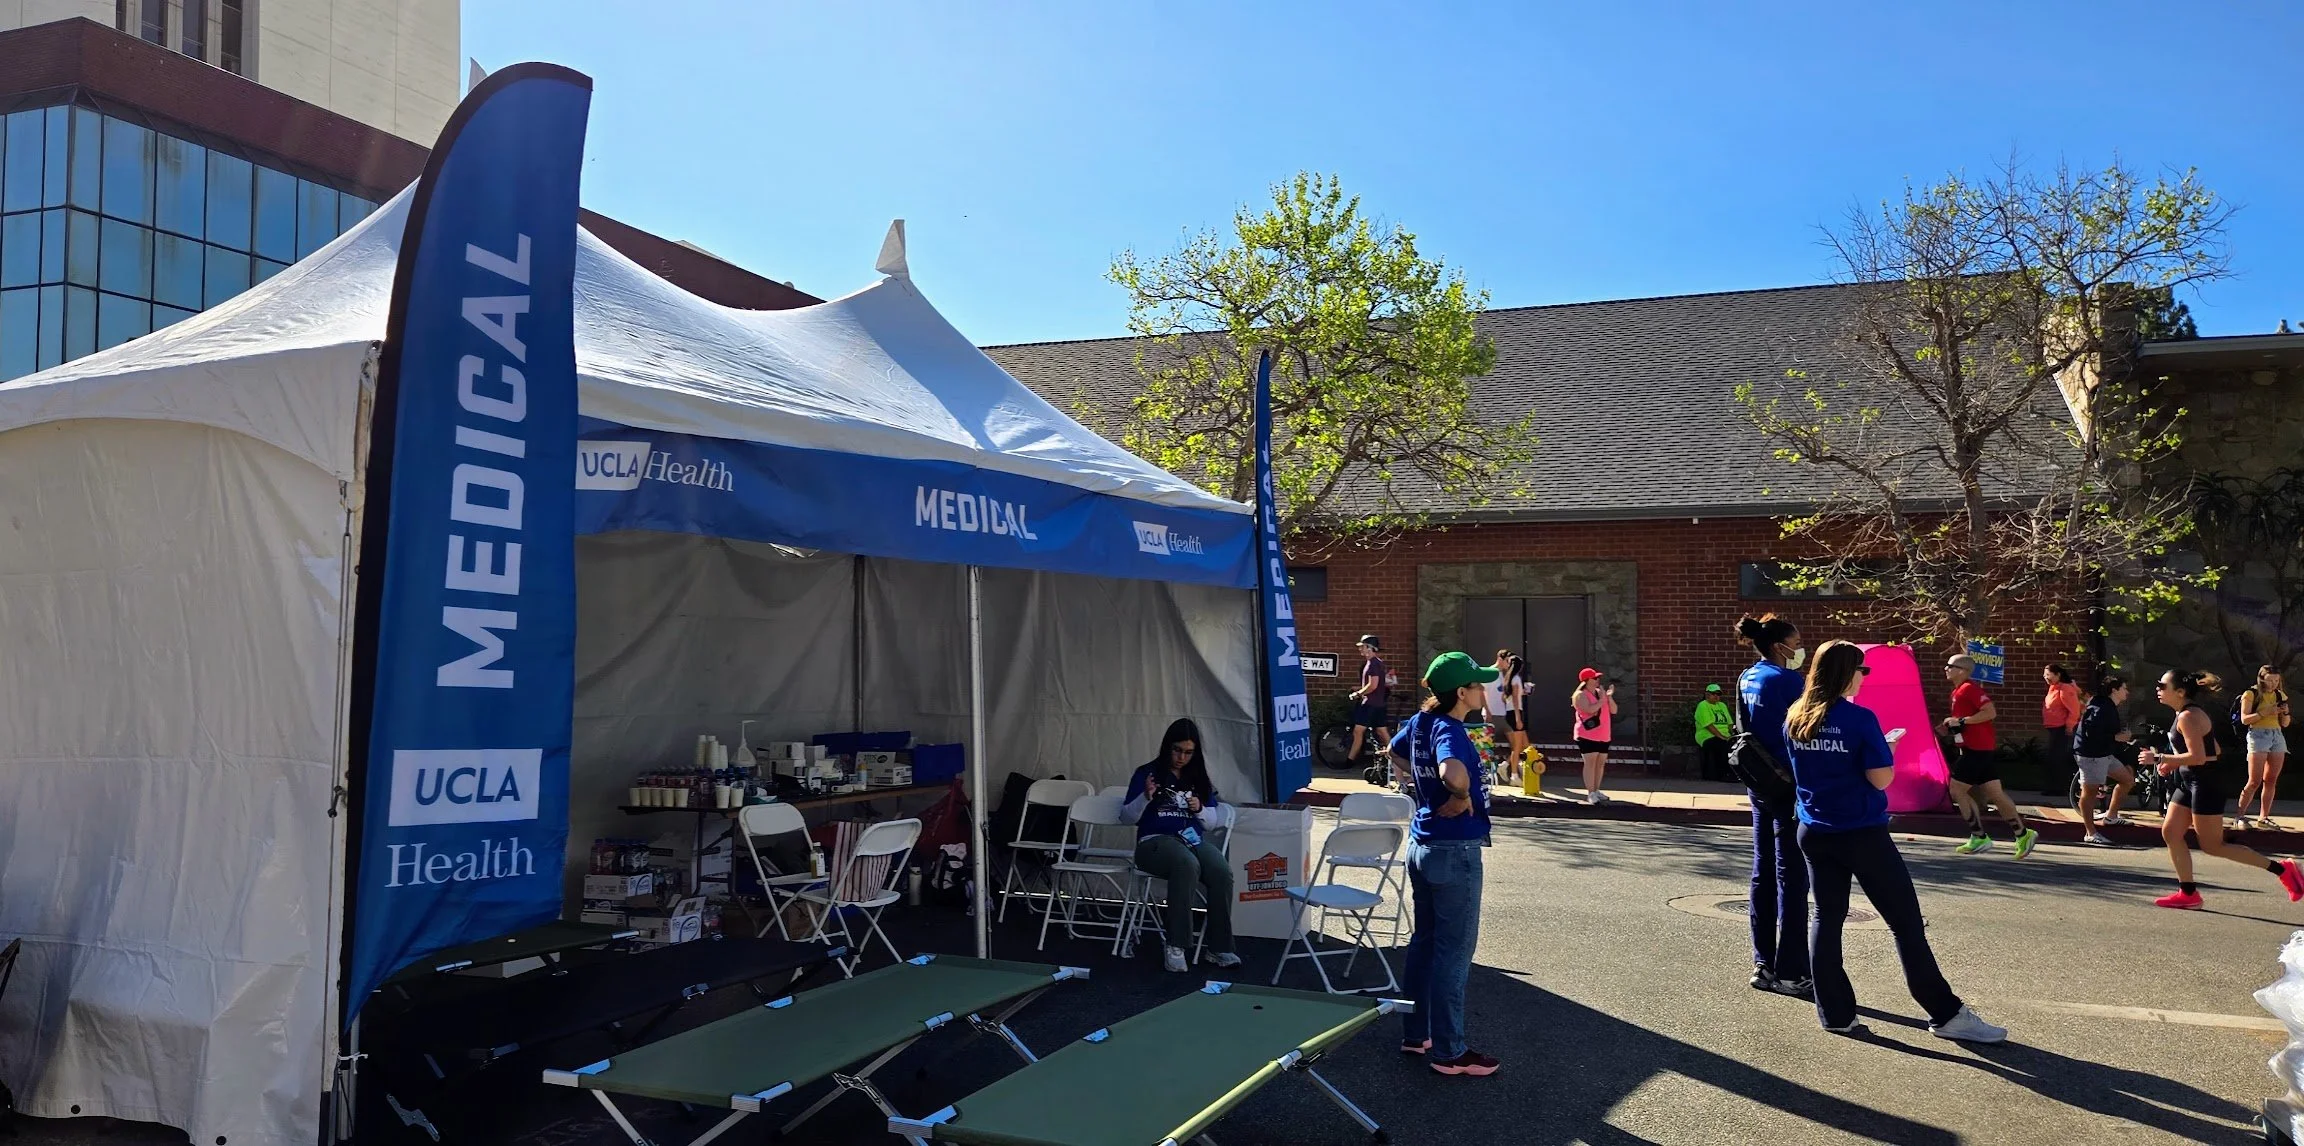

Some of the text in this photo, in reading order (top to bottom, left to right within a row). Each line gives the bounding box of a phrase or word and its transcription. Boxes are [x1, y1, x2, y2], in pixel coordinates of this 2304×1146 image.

[436, 232, 532, 689] MEDICAL
[582, 450, 734, 492] UCLA Health
[915, 485, 1038, 541] MEDICAL
[1138, 529, 1205, 555] UCLA Health
[1311, 659, 1330, 669] WAY
[1969, 650, 2003, 668] PARKVIEW
[1278, 702, 1307, 723] UCLA
[1793, 738, 1849, 753] MEDICAL
[414, 764, 522, 806] UCLA
[384, 836, 537, 888] Health
